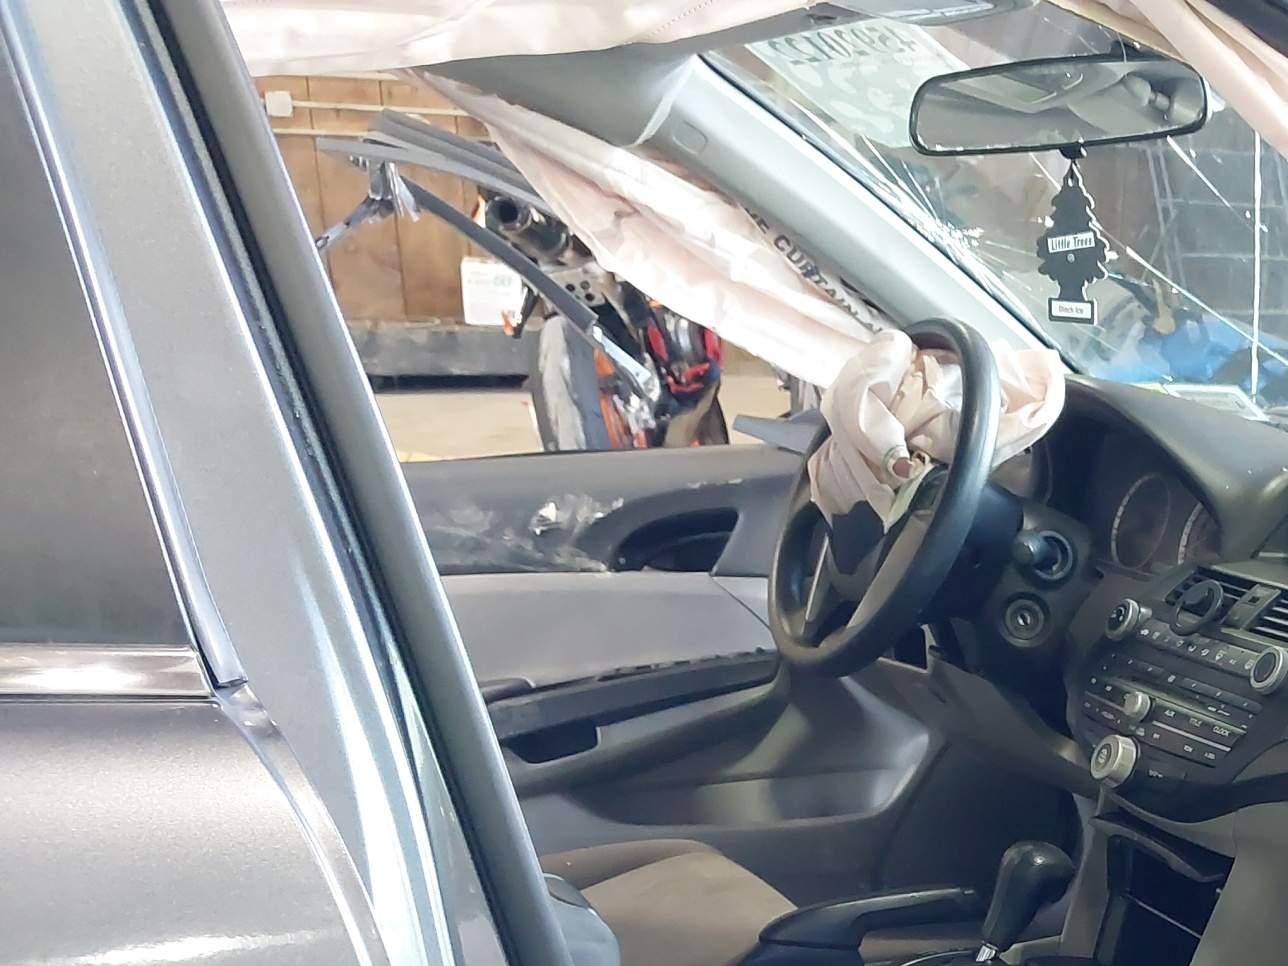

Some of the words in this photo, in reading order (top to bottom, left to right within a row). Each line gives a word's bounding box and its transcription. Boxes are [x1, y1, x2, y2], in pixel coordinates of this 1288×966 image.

[1051, 238, 1071, 251] Little
[1073, 236, 1092, 248] Trees
[1212, 725, 1231, 737] CLOCK
